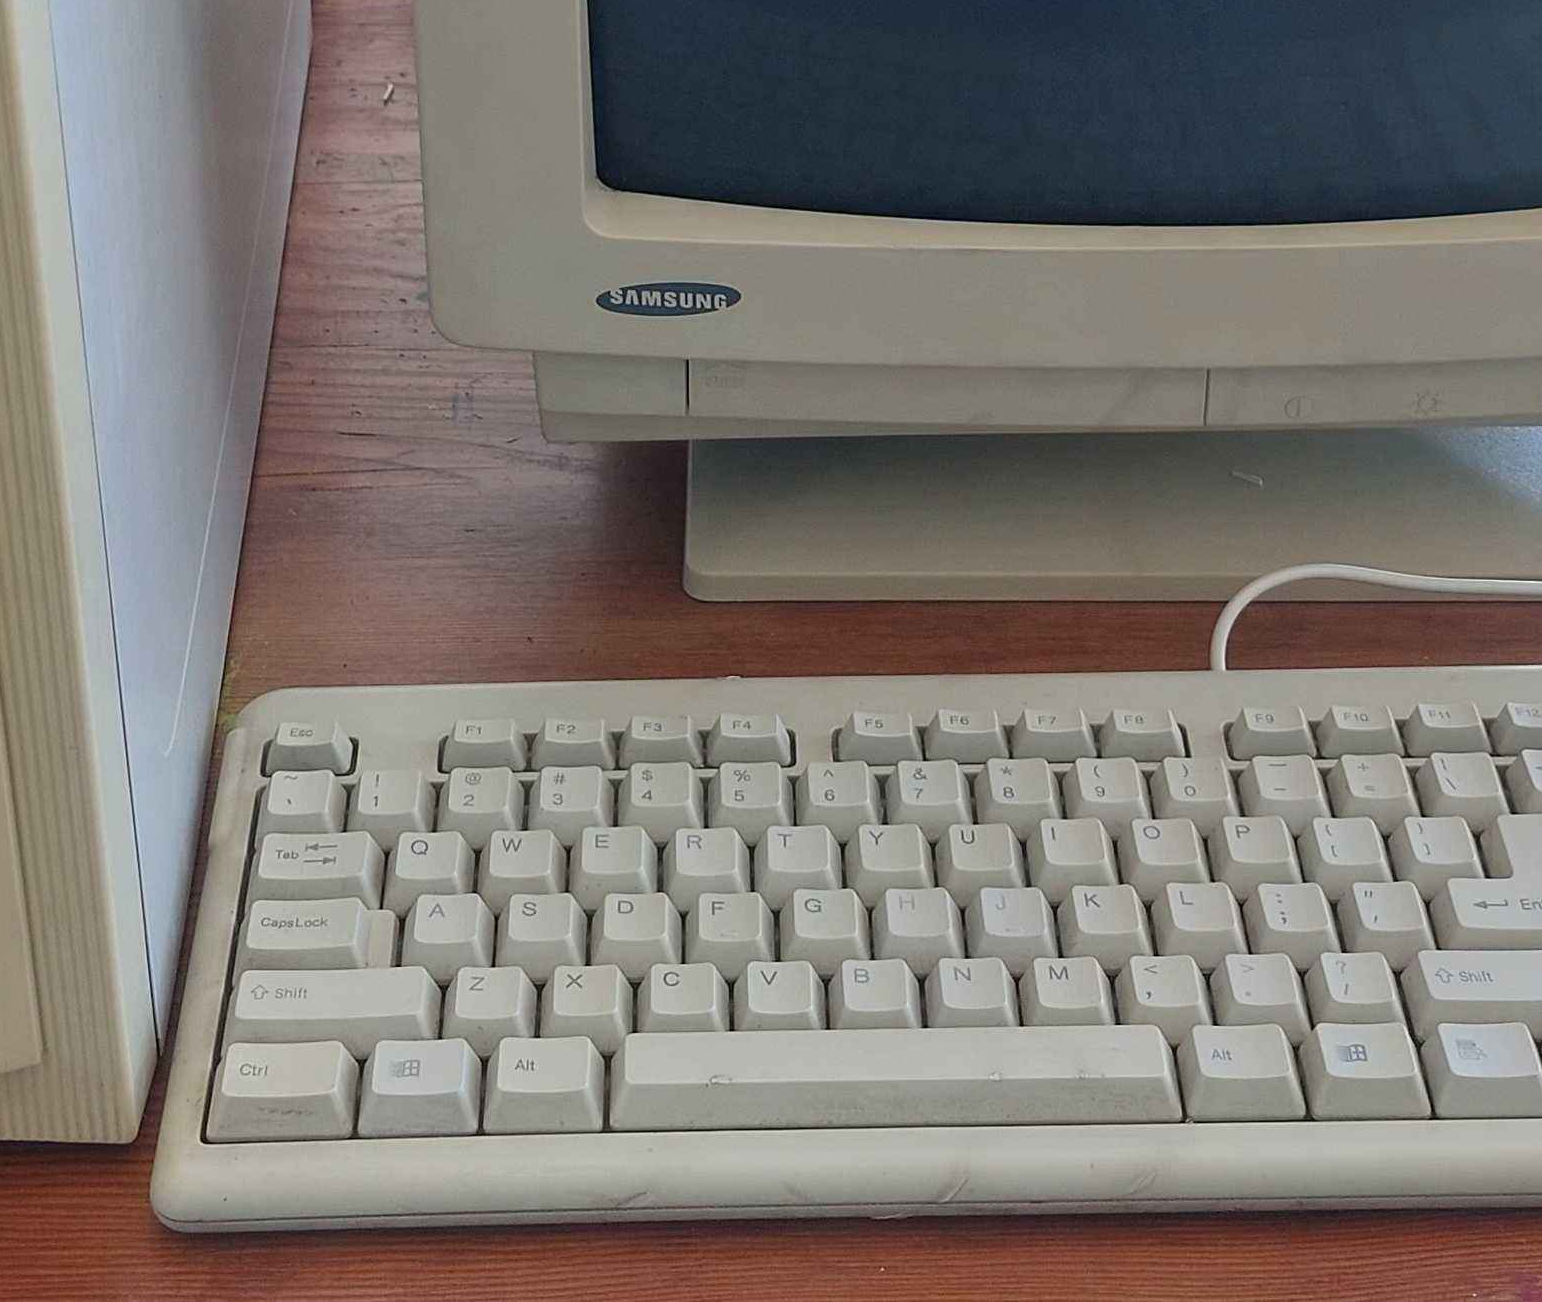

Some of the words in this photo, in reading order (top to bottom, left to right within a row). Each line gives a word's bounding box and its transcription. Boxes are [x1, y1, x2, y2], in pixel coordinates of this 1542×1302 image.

[610, 289, 728, 309] SAMSUNG
[1255, 713, 1275, 724] F9
[1343, 713, 1370, 724] F10
[1427, 710, 1451, 721] F11
[1514, 707, 1542, 718] F12
[732, 720, 752, 731] F4
[864, 718, 884, 729] F5
[949, 715, 970, 726] F6
[1037, 715, 1057, 726] F7
[1124, 715, 1144, 725] F8
[289, 728, 314, 738] Esc
[465, 725, 483, 736] F1
[556, 724, 576, 735] F2
[643, 722, 662, 733] F3
[913, 767, 928, 780] &
[1357, 762, 1369, 772] +
[464, 771, 482, 786] @
[553, 772, 566, 785] #
[641, 769, 654, 782] $
[733, 769, 752, 782] %
[641, 789, 654, 802] 4
[733, 789, 745, 802] 5
[824, 789, 836, 802] 6
[913, 787, 924, 800] 7
[1002, 786, 1015, 799] 8
[1094, 785, 1106, 799] 9
[372, 794, 380, 808] 1
[462, 794, 475, 807] 2
[552, 793, 564, 806] 3
[868, 831, 886, 846] Y
[960, 830, 976, 845] U
[1142, 825, 1161, 840] O
[1234, 824, 1250, 839] P
[502, 838, 524, 853] W
[595, 834, 610, 849] E
[686, 834, 703, 850] R
[776, 833, 793, 848] T
[275, 849, 300, 860] Tab
[410, 840, 429, 856] Q
[899, 896, 916, 911] H
[996, 896, 1007, 911] J
[1083, 893, 1101, 908] K
[1179, 890, 1195, 906] L
[428, 903, 447, 918] A
[522, 901, 537, 916] S
[617, 900, 634, 914] D
[711, 901, 725, 916] F
[804, 898, 822, 913] G
[953, 966, 972, 982] N
[1048, 965, 1070, 982] M
[1144, 964, 1158, 975] <
[1240, 963, 1255, 974] >
[1335, 960, 1347, 975] ?
[565, 973, 584, 989] X
[663, 971, 681, 987] C
[760, 970, 778, 986] V
[854, 968, 870, 984] B
[1458, 969, 1495, 984] Shift
[468, 976, 485, 992] Z
[274, 987, 308, 1000] Shift
[1211, 1047, 1233, 1062] Alt
[239, 1063, 269, 1077] Ctrl
[514, 1058, 536, 1072] Alt
